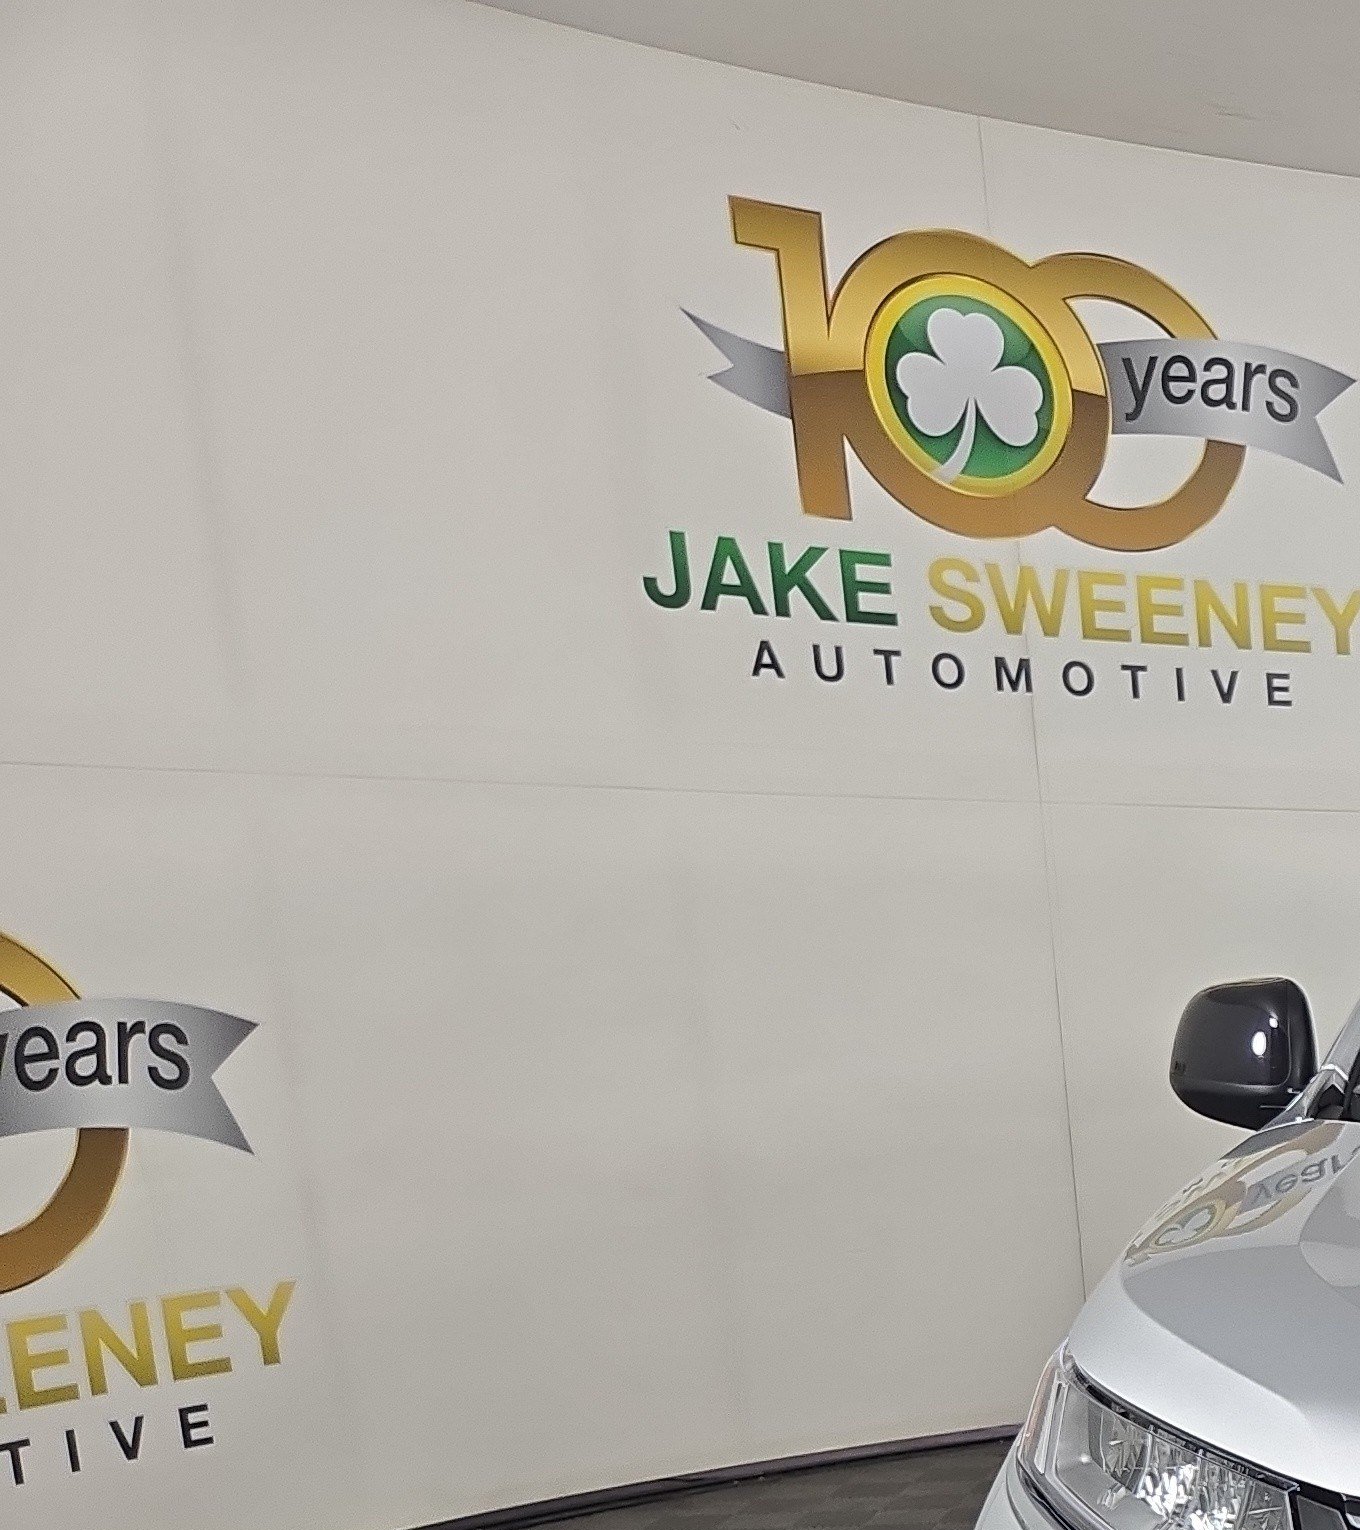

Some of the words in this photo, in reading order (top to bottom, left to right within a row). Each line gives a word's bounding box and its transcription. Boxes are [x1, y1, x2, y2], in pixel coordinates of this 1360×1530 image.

[727, 195, 1246, 552] 100
[1121, 353, 1300, 422] years
[643, 530, 898, 626] JAKE
[751, 641, 1293, 707] AUTOMOTIVE
[0, 1019, 190, 1093] ears
[0, 1280, 295, 1414] ENEY
